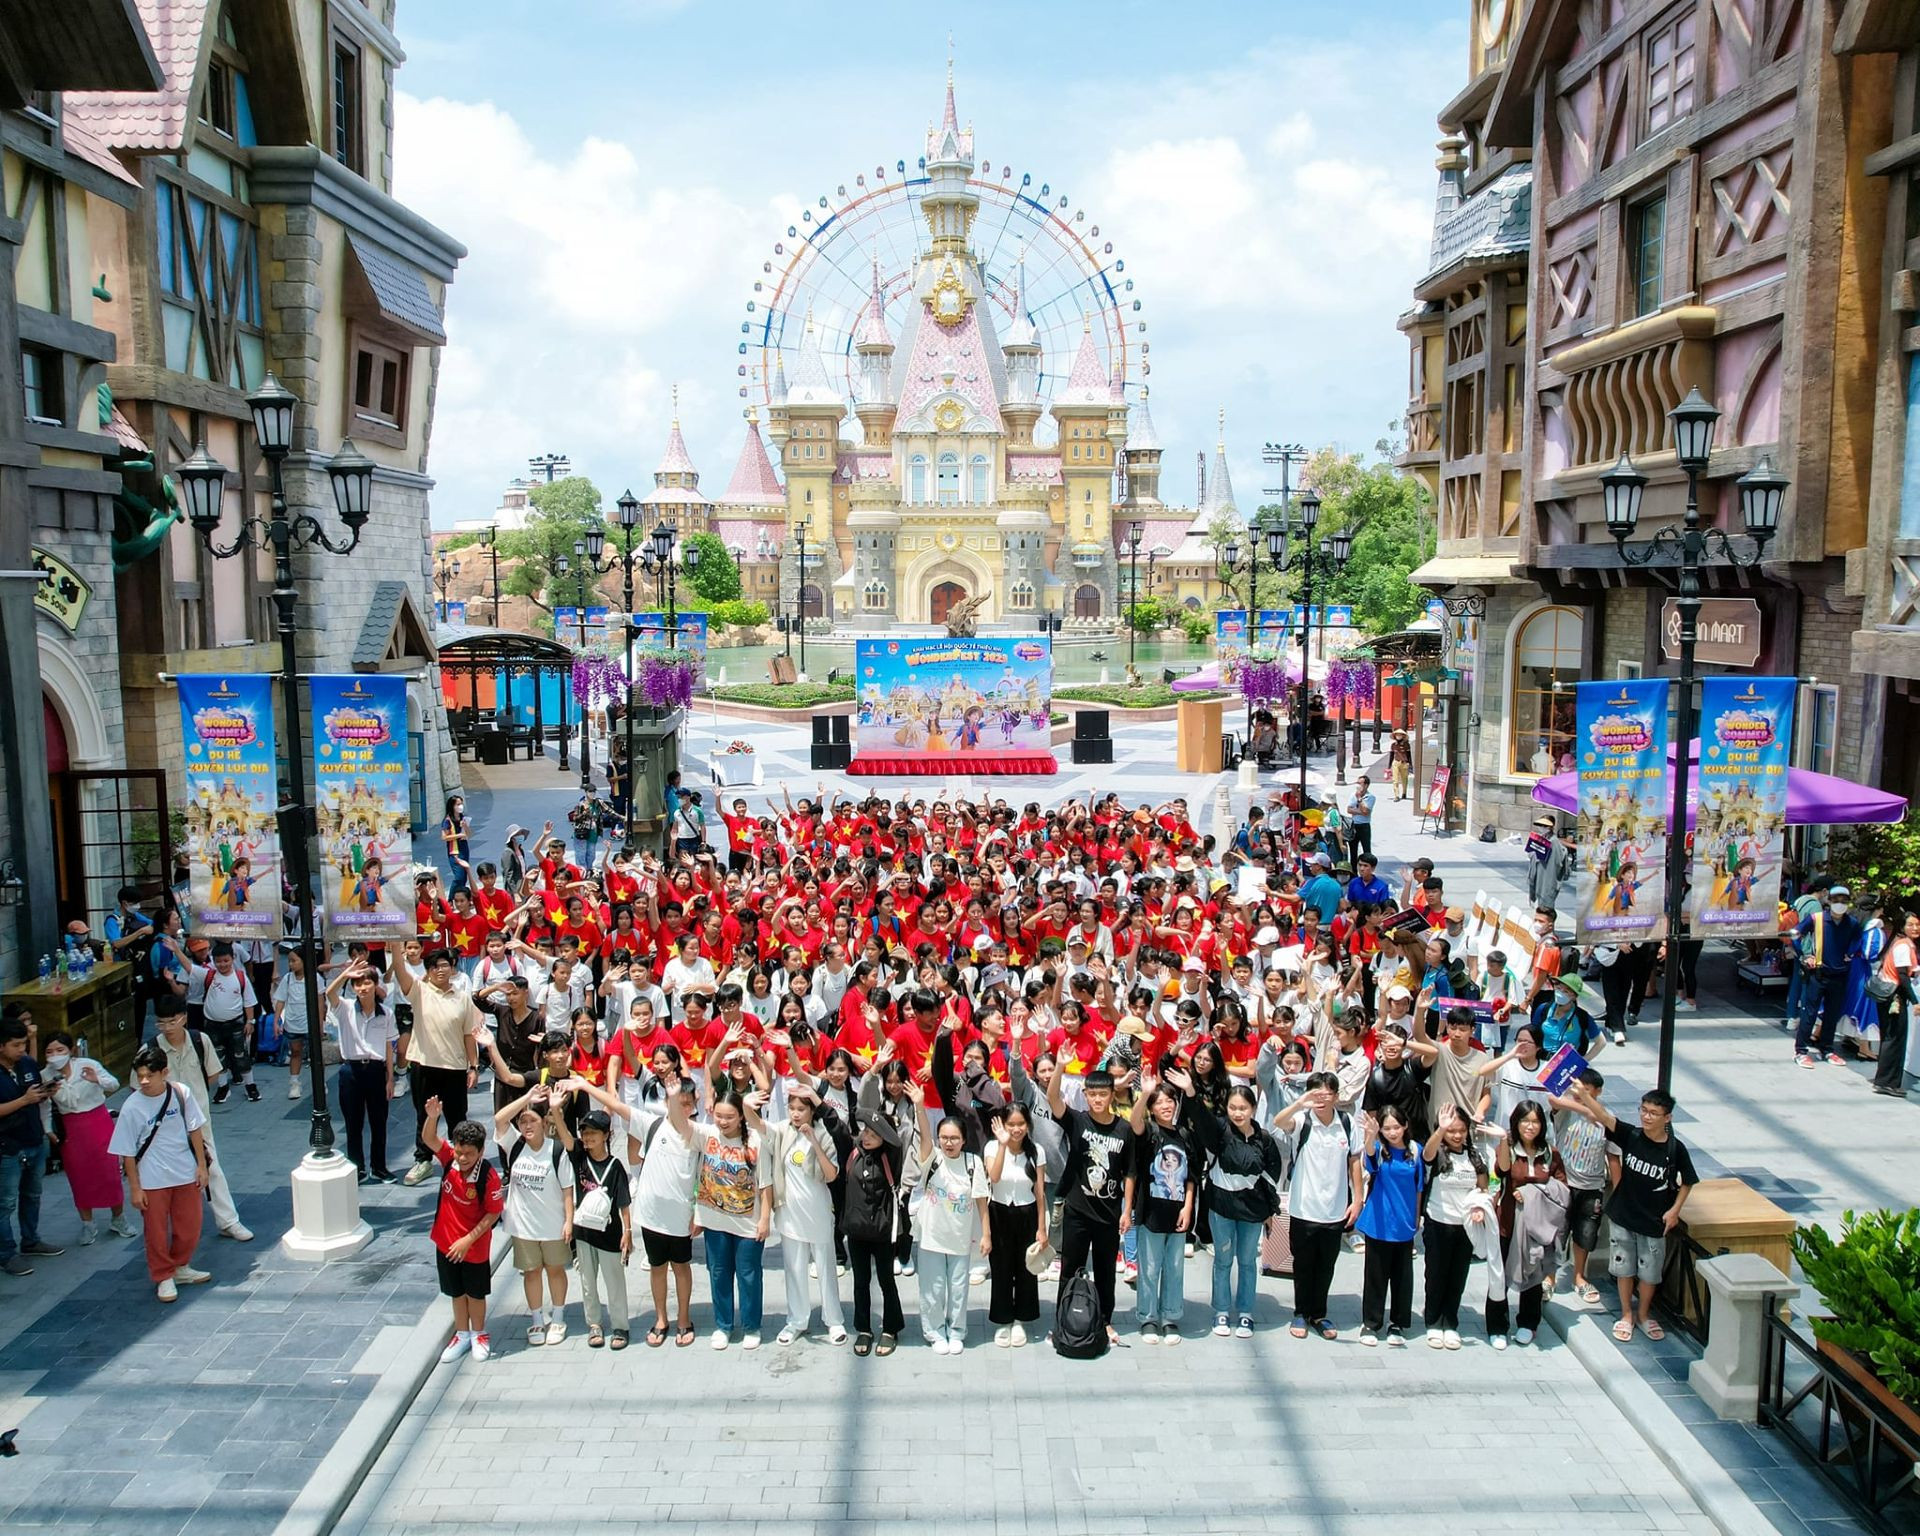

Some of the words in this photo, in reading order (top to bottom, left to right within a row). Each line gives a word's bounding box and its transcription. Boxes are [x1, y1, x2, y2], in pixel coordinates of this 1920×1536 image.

[1711, 620, 1745, 644] MART
[203, 719, 244, 728] WONDER
[335, 719, 378, 728] WONDER
[1726, 721, 1767, 730] WONDER
[202, 728, 247, 738] SUMMER
[334, 728, 380, 738] SUMMER
[1601, 726, 1642, 735] WONDER
[1724, 730, 1768, 740] SUMMER
[215, 738, 236, 746] 2023
[347, 738, 369, 746] 2023
[1600, 734, 1645, 744] SUMMER
[1734, 740, 1757, 748] 2023
[1610, 745, 1632, 754] 2023
[210, 750, 224, 760] DU
[341, 750, 356, 760] DU
[1728, 752, 1742, 762] DU
[1604, 758, 1618, 767] DU
[1218, 1316, 1227, 1325] C
[1240, 1317, 1249, 1327] C
